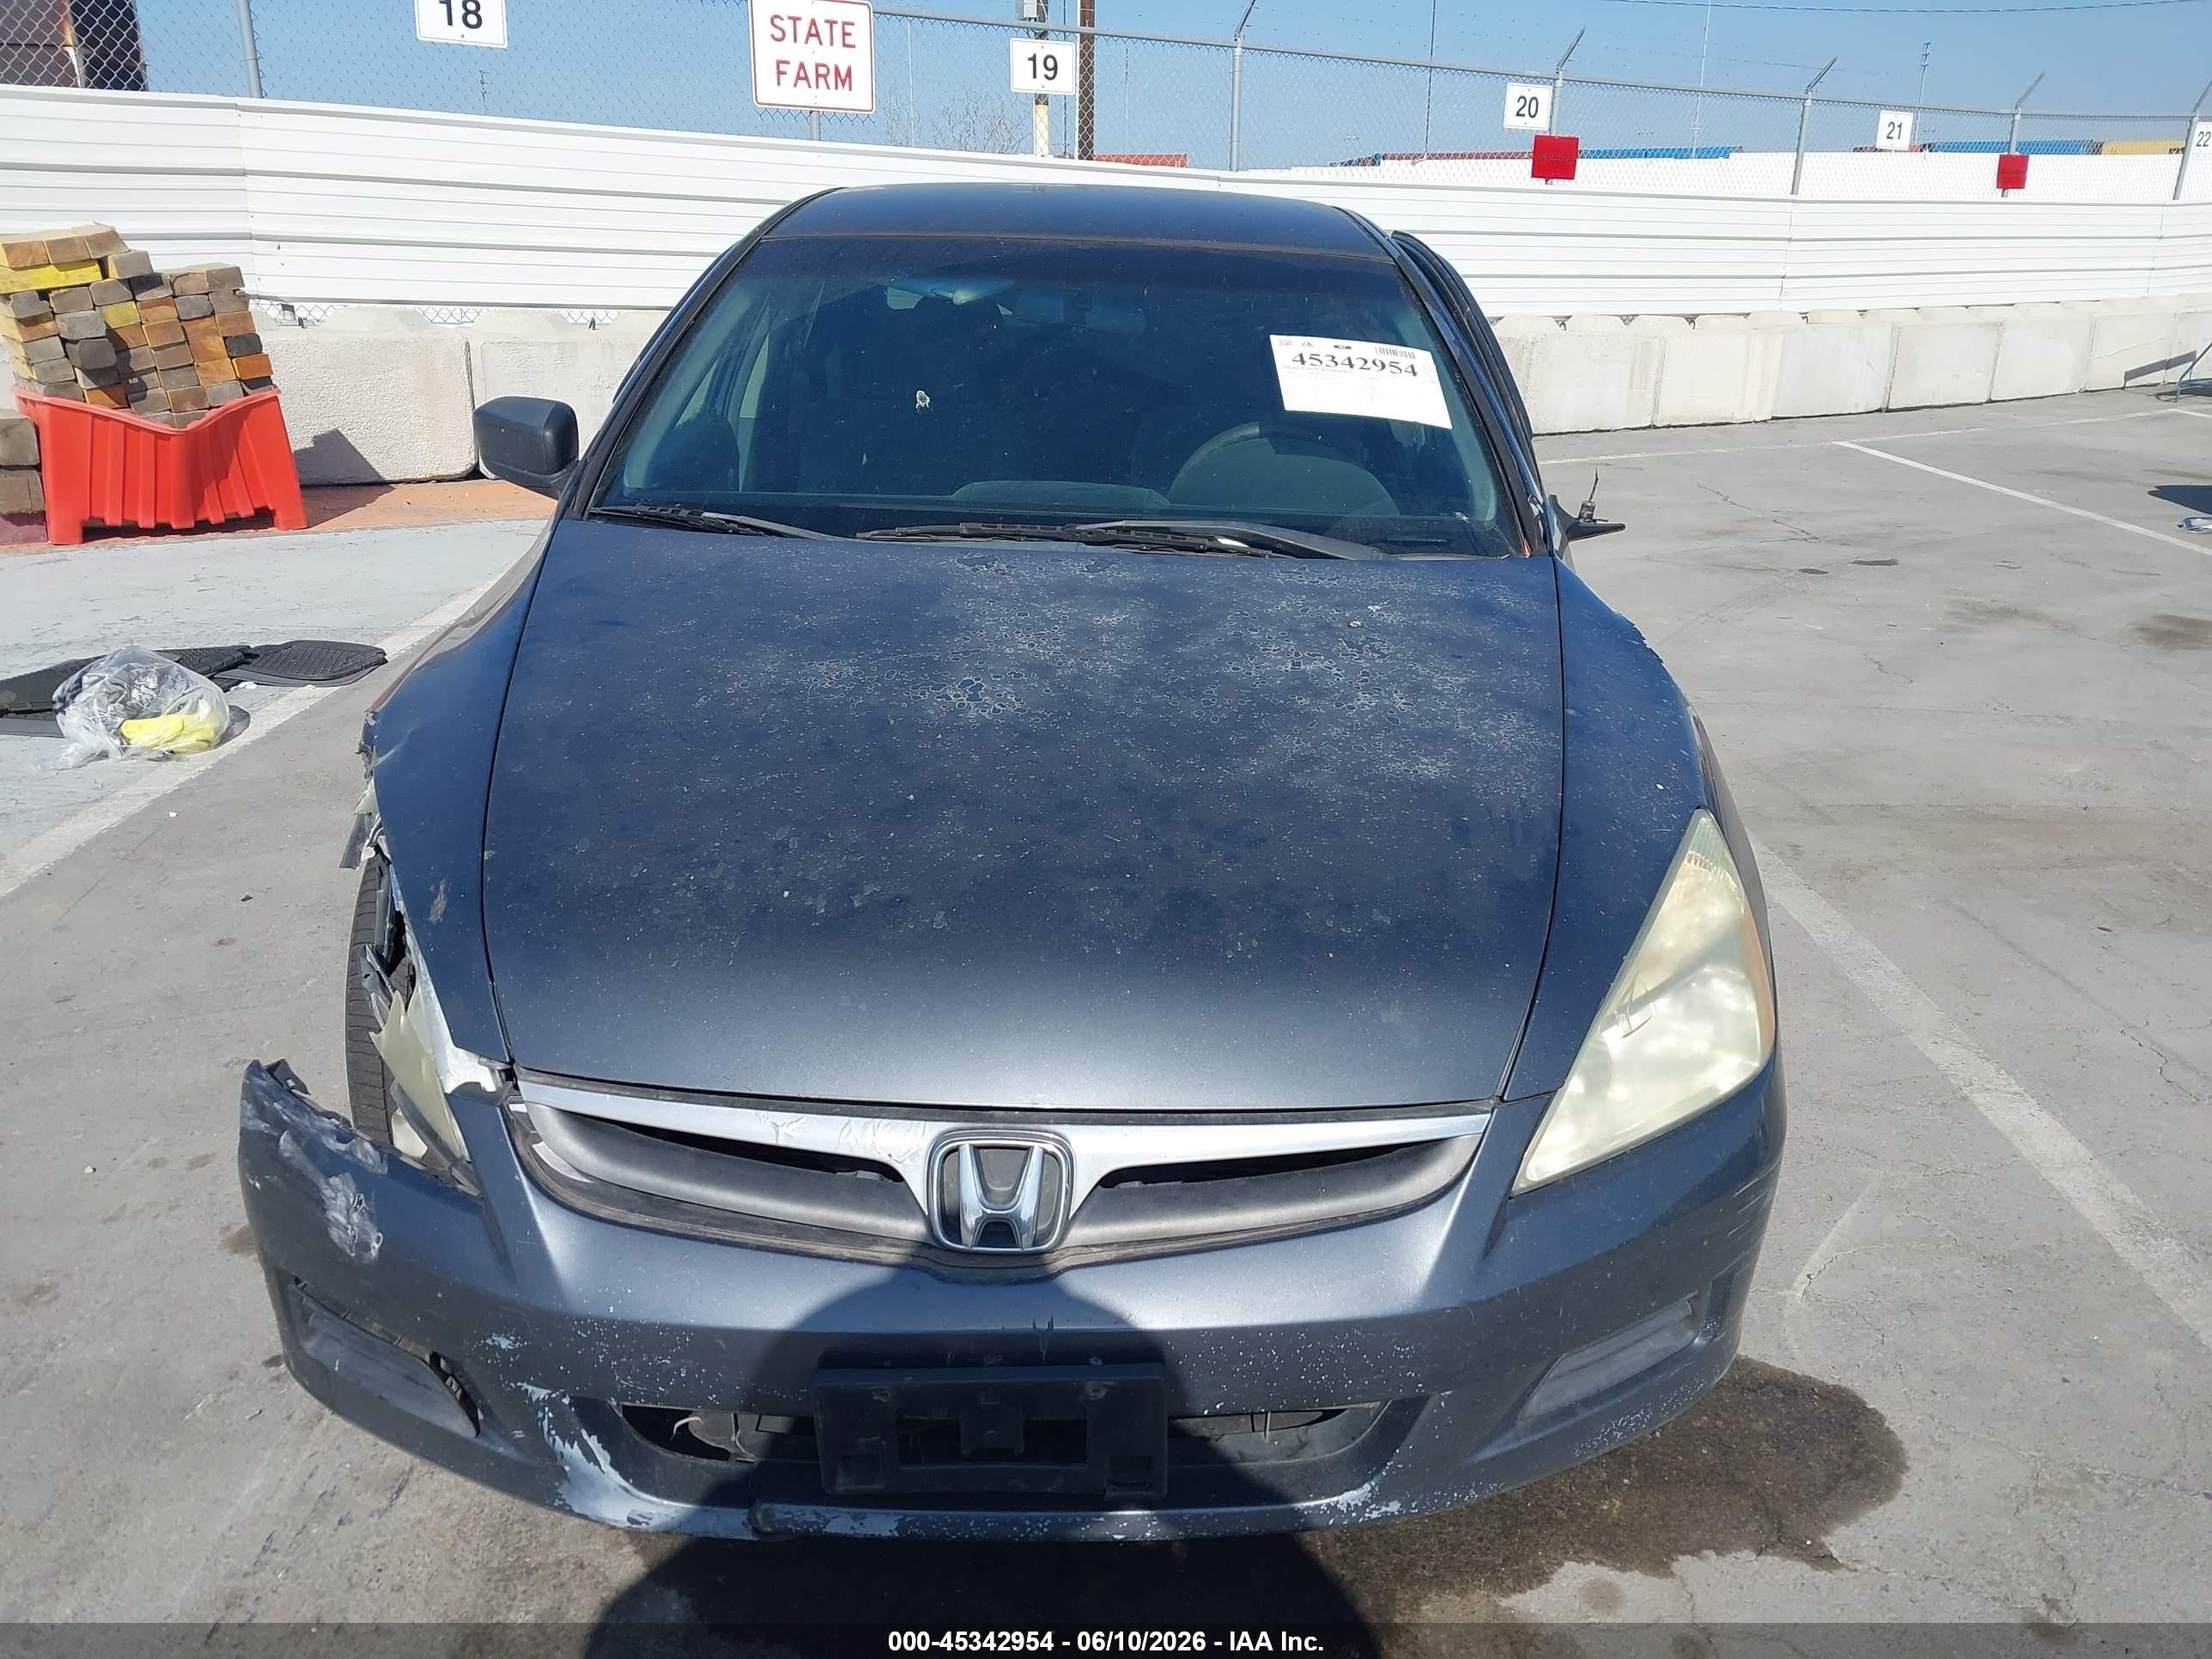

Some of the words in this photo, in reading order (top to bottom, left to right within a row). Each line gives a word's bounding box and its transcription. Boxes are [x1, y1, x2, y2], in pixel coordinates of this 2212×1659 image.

[439, 0, 483, 29] 18
[769, 14, 856, 48] STATE
[775, 59, 853, 92] FARM
[1027, 53, 1059, 81] 19
[1516, 95, 1539, 118] 20
[1887, 121, 1903, 140] 21
[2196, 131, 2211, 147] 22
[1291, 352, 1419, 377] 45342954
